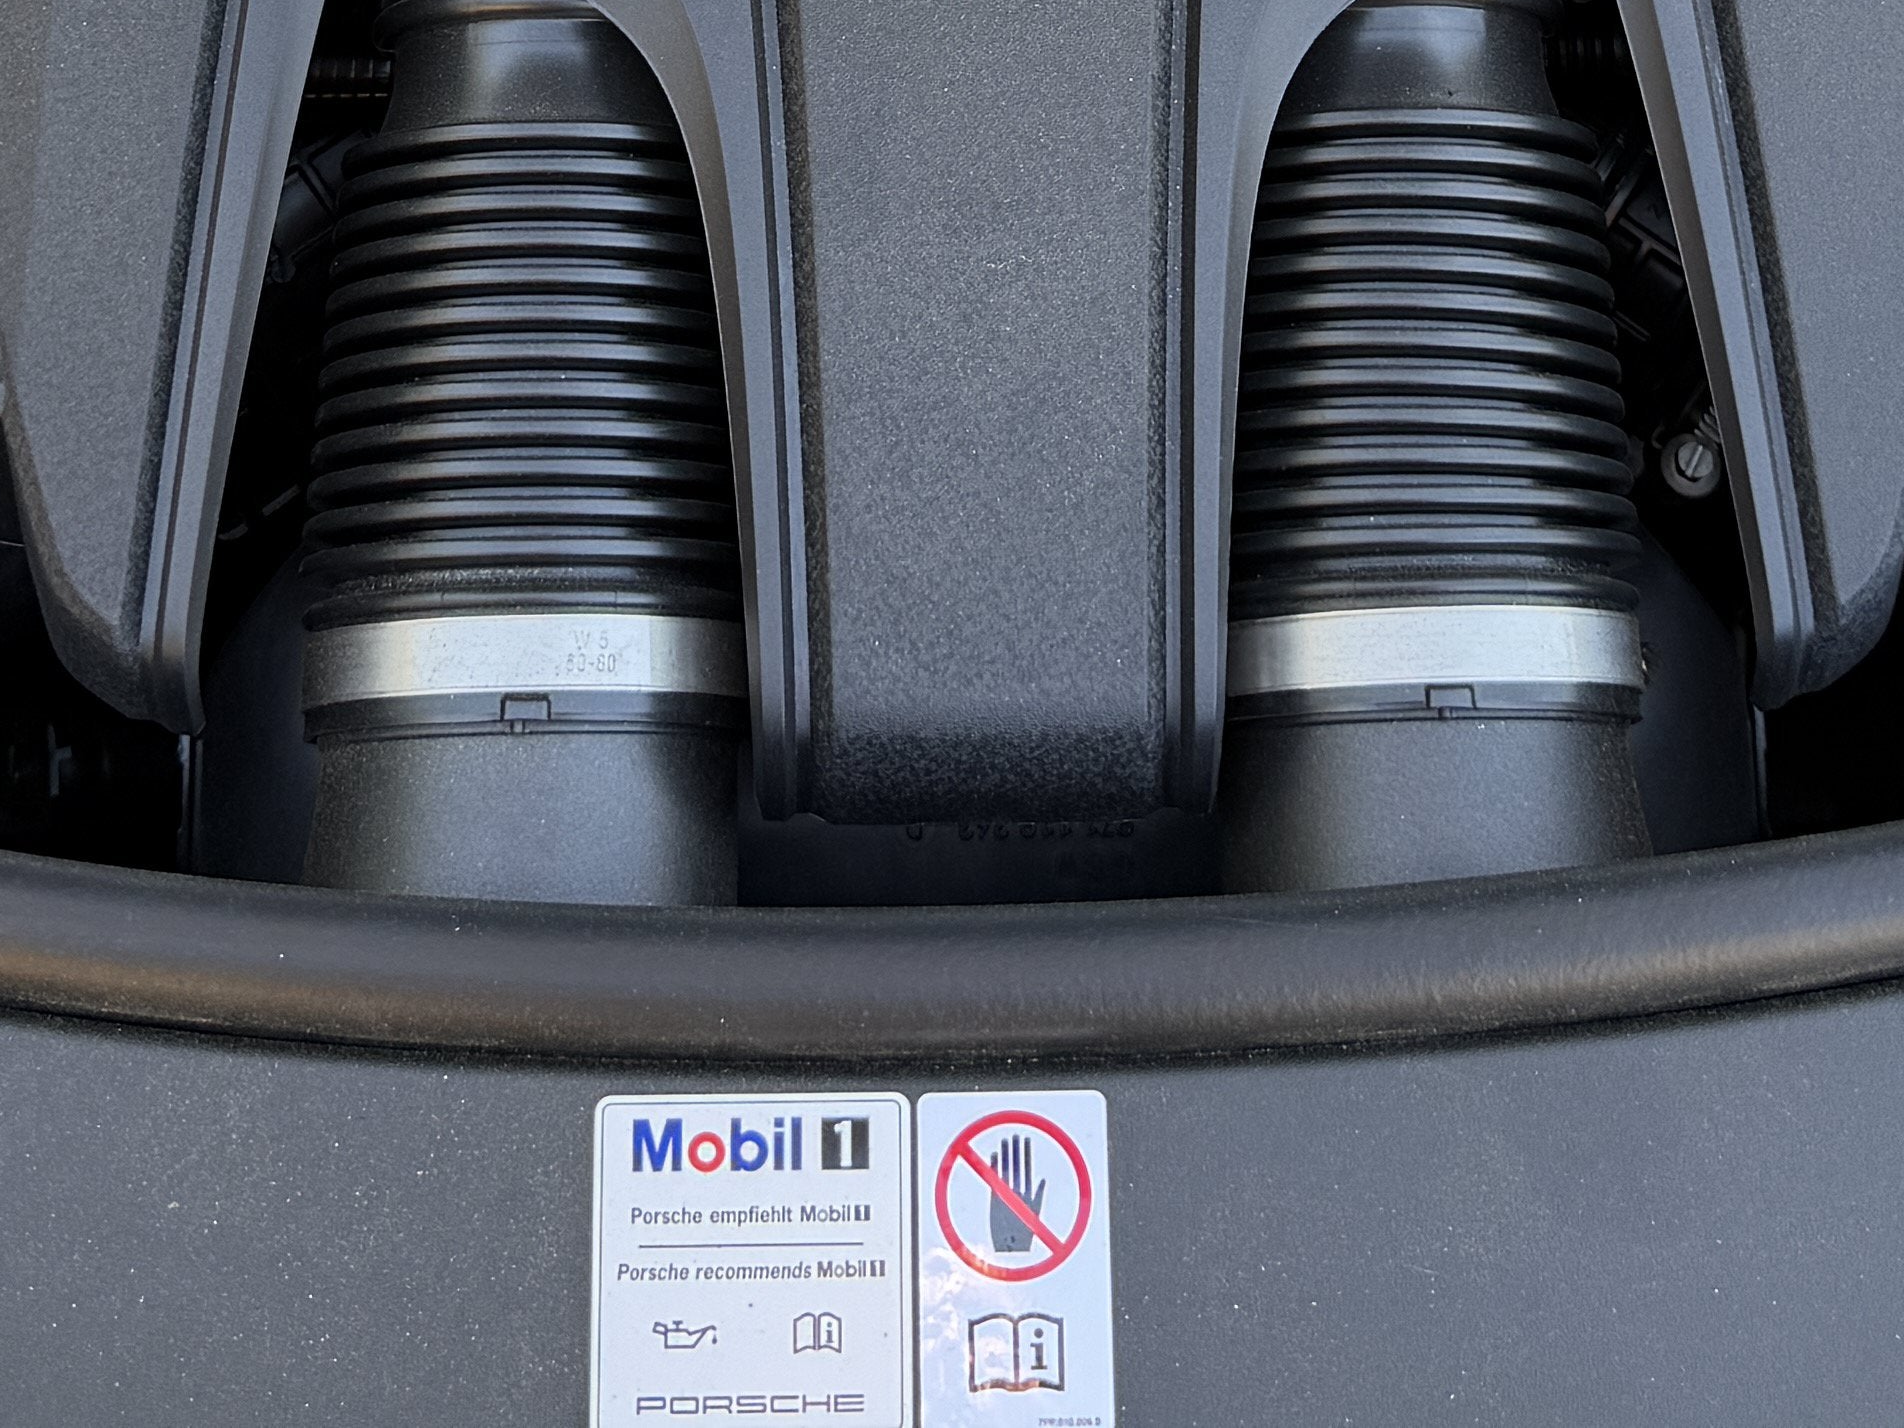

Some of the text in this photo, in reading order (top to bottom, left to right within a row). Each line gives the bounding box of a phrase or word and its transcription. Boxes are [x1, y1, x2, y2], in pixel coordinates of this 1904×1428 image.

[632, 1117, 802, 1172] Mobil
[630, 1206, 703, 1226] Porsche
[709, 1205, 793, 1228] empfiehlt
[616, 1261, 691, 1282] Porsche
[695, 1261, 812, 1281] recommends
[635, 1393, 866, 1416] PORSCHE
